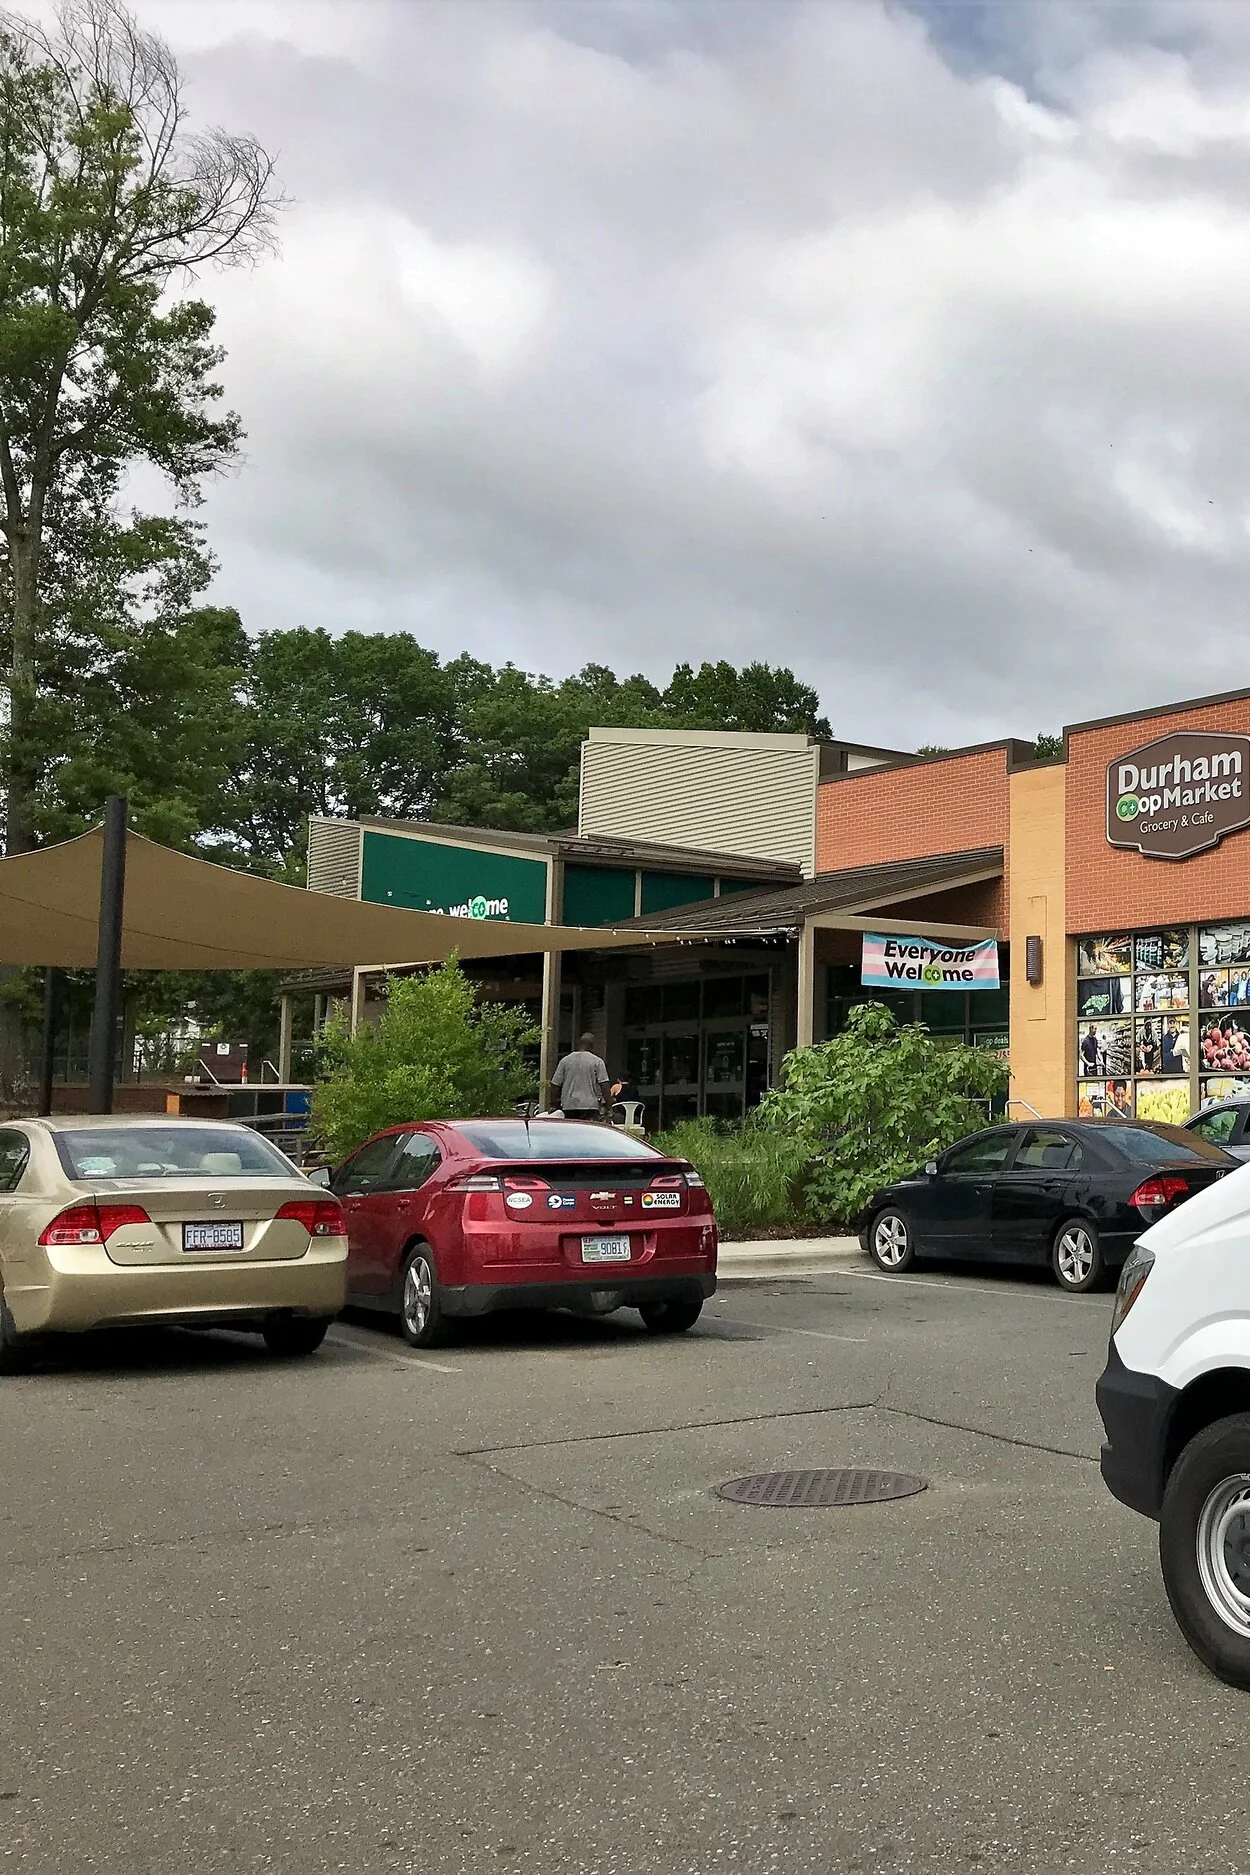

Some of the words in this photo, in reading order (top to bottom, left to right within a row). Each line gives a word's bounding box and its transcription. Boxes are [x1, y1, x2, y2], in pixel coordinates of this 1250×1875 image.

[1118, 750, 1242, 795] Durham
[1139, 818, 1179, 834] Grocery
[1181, 815, 1189, 827] &
[1191, 811, 1214, 826] Cafe
[883, 939, 976, 965] Everyone
[884, 961, 974, 984] Welcome
